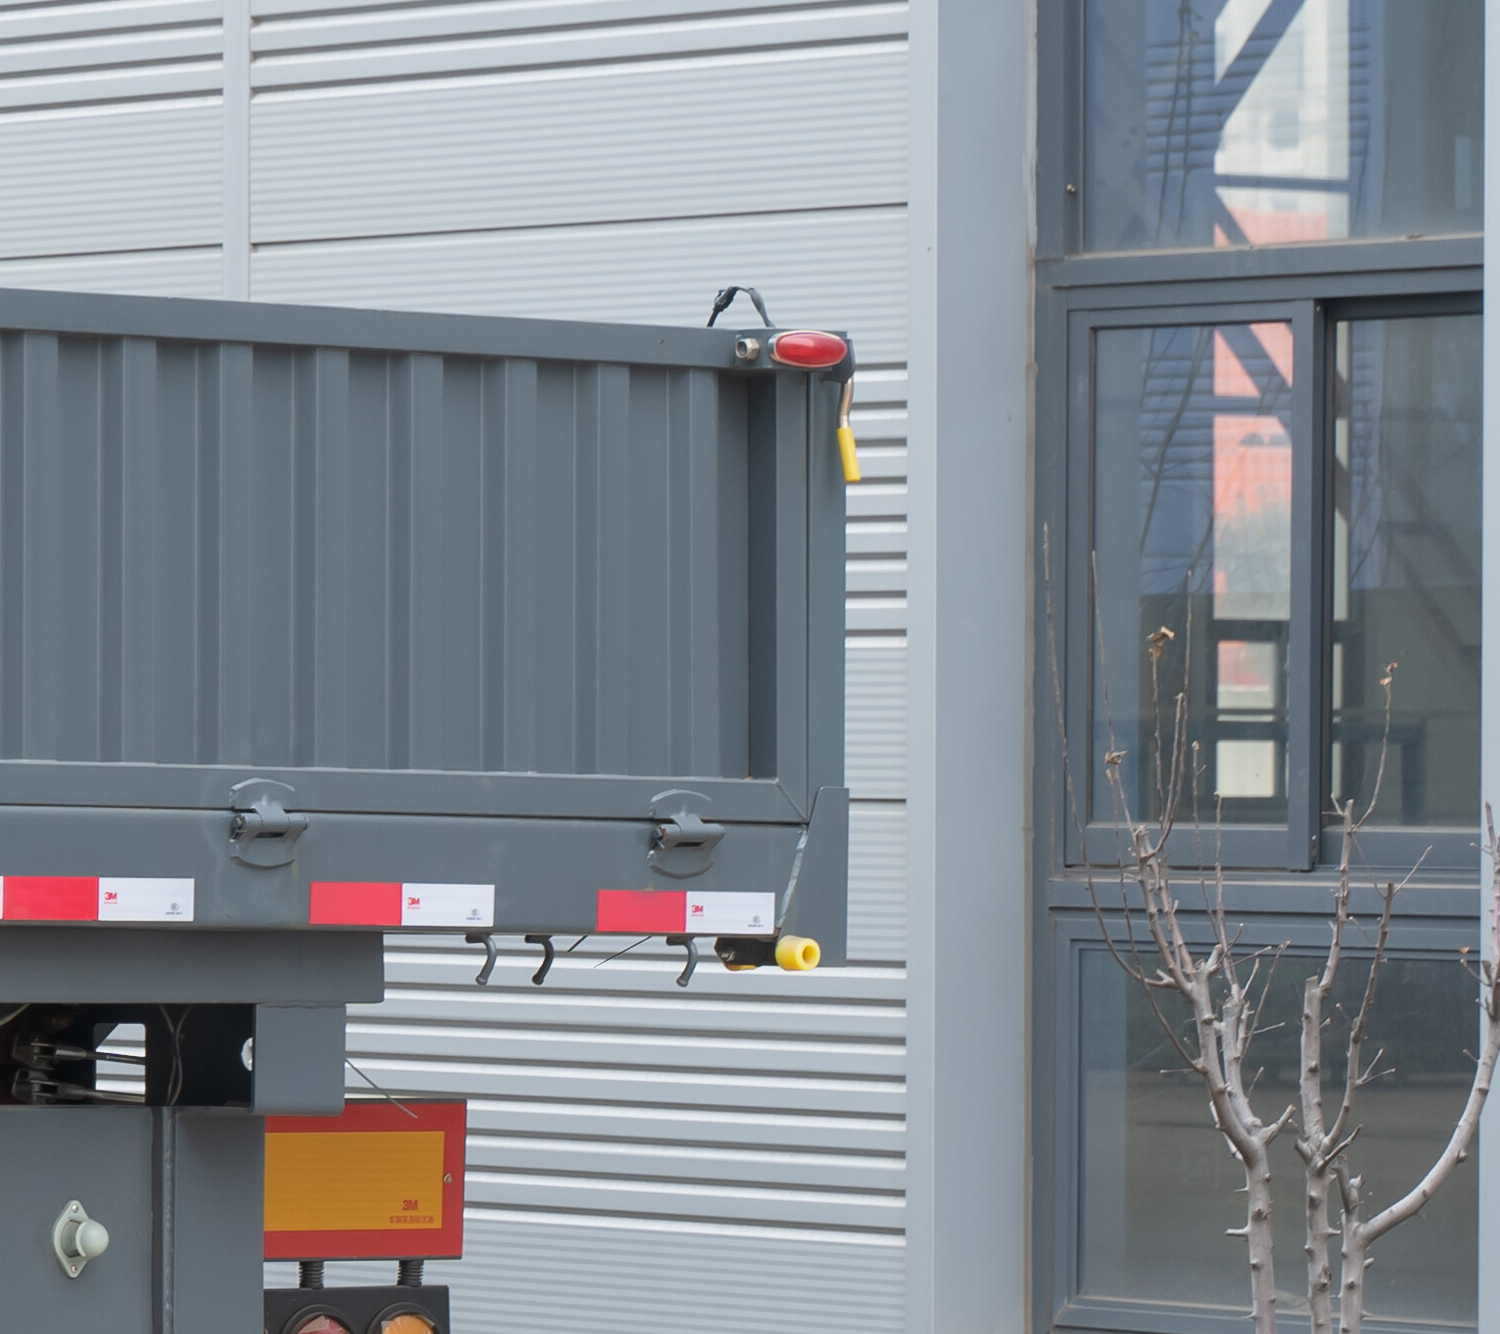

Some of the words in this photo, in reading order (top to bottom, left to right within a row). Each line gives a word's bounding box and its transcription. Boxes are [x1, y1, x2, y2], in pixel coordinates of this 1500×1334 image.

[104, 892, 117, 901] 3M
[407, 897, 420, 906] 3M
[691, 904, 703, 913] 3M
[402, 1199, 419, 1212] 3M
